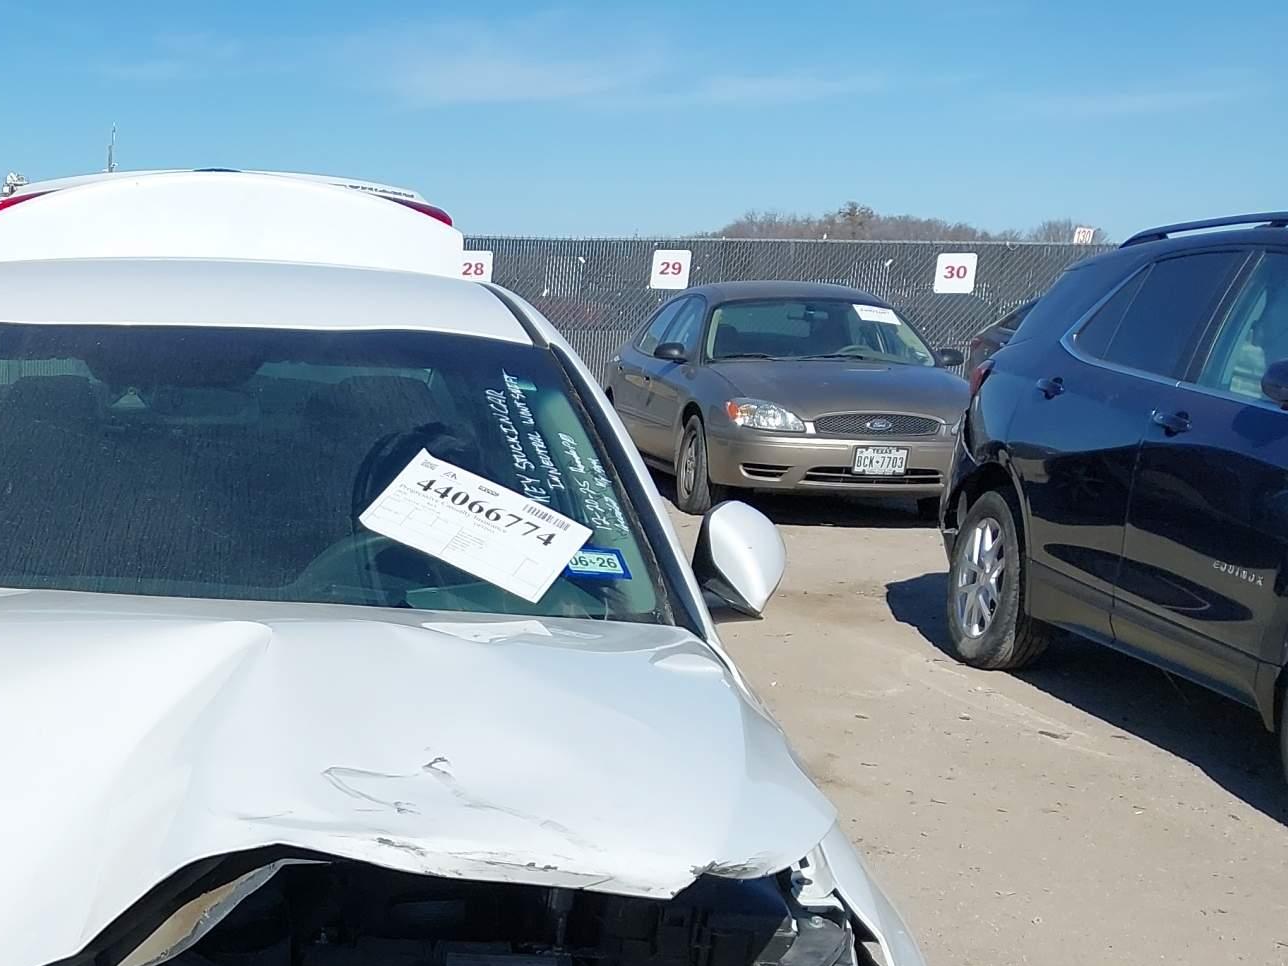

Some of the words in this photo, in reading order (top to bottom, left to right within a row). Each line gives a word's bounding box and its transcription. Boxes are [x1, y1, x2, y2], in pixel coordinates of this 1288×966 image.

[462, 262, 484, 276] 28
[659, 261, 682, 276] 29
[943, 265, 968, 279] 30
[416, 479, 558, 547] 44066774
